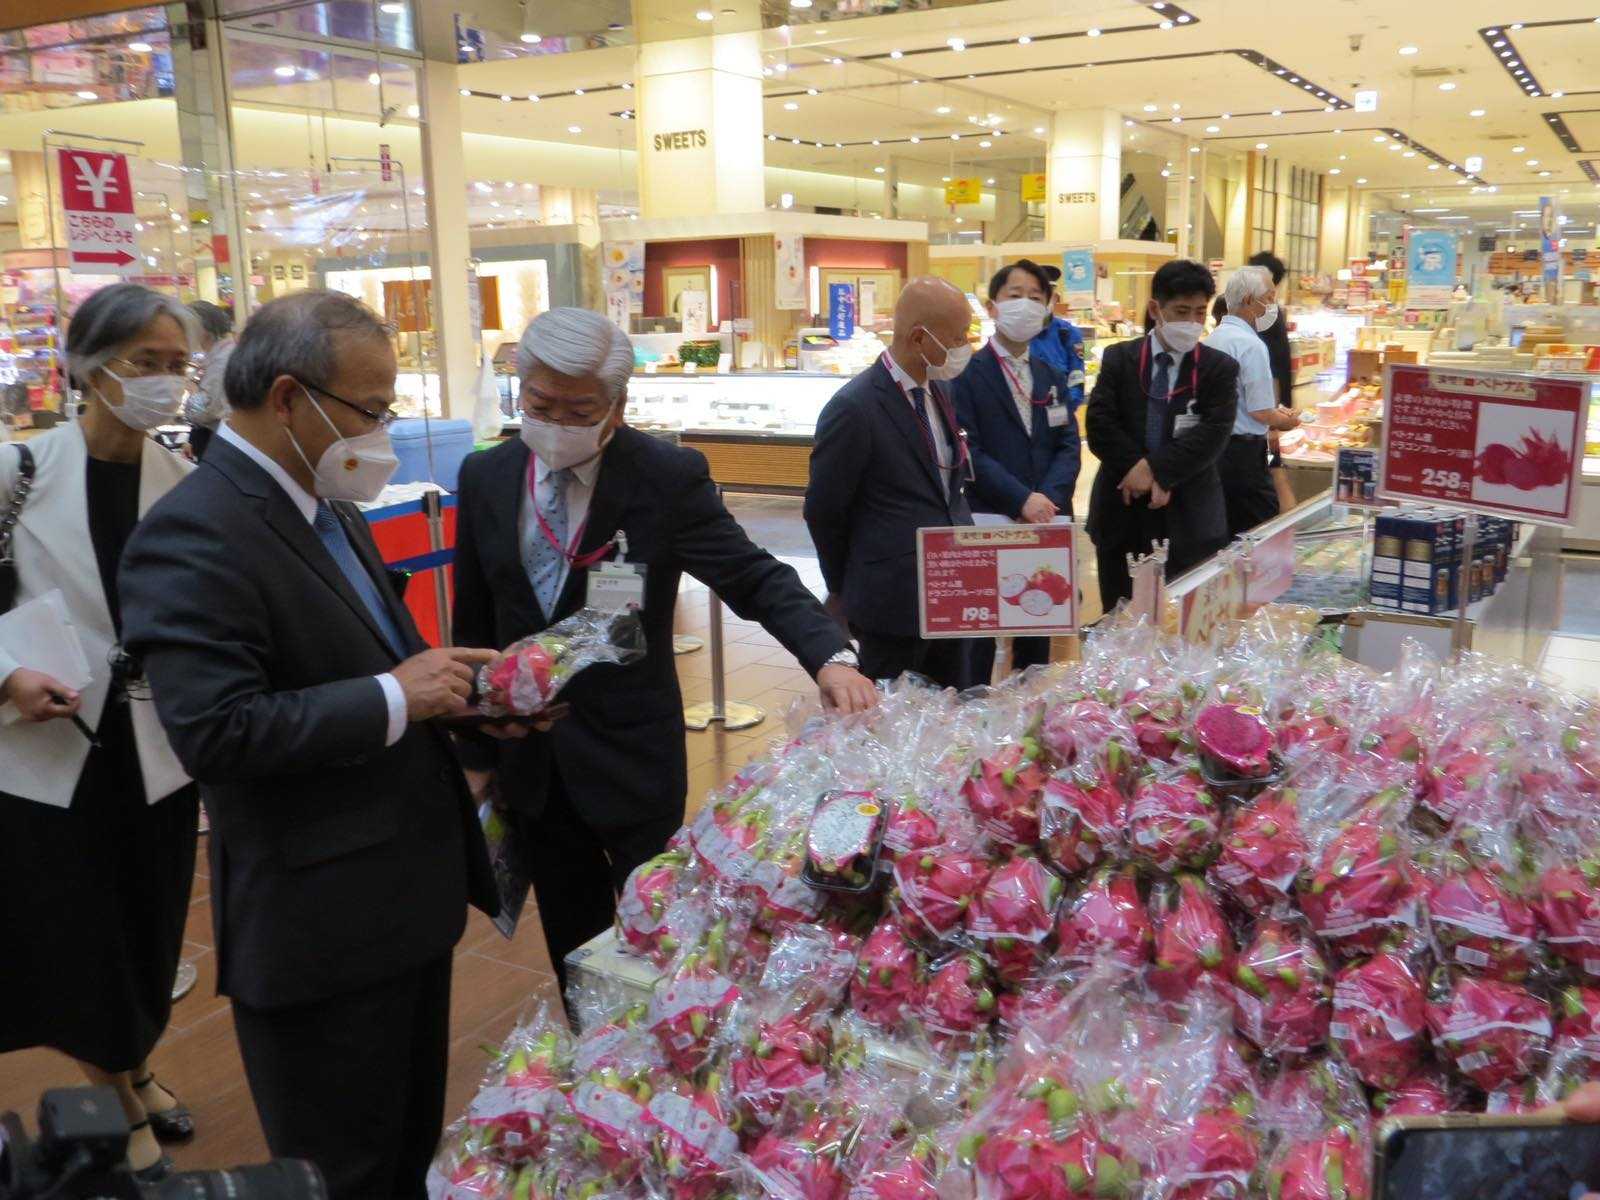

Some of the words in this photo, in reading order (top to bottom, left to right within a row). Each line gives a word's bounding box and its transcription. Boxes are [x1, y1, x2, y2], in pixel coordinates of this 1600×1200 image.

[654, 129, 706, 151] SWEETS
[1058, 192, 1096, 203] SWEETS
[69, 214, 116, 229] こちらの
